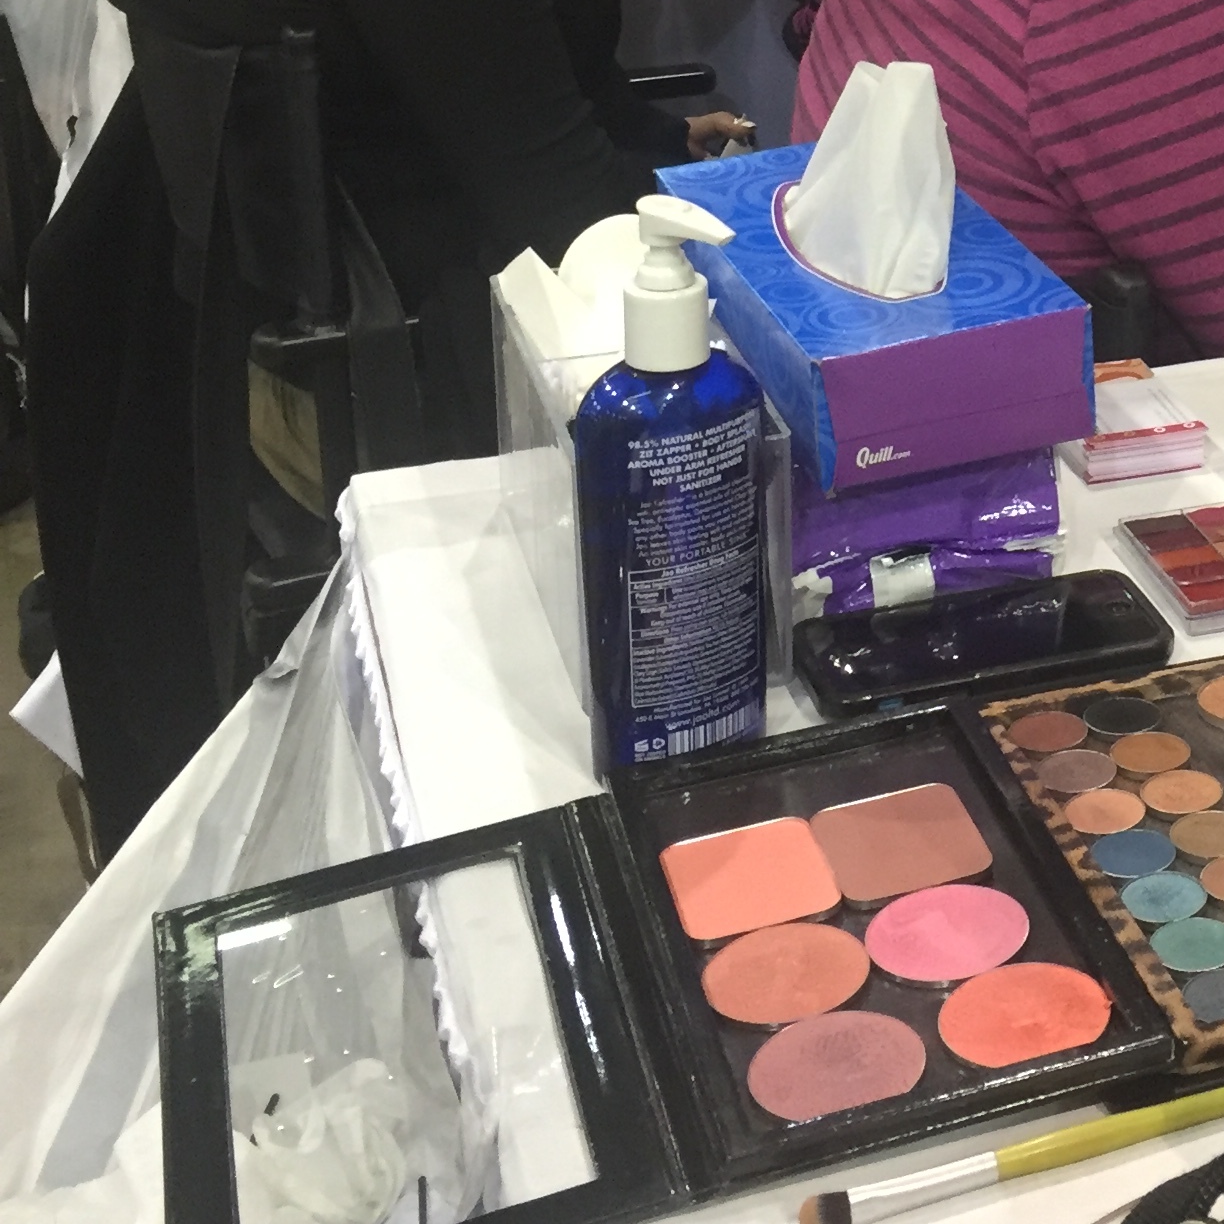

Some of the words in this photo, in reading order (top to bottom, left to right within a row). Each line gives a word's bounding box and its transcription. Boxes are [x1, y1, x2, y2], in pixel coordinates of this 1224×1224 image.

[628, 438, 659, 450] 98.5%
[661, 431, 703, 447] NATURAL
[627, 458, 665, 469] AROMA
[667, 449, 708, 464] BOOSTER
[639, 450, 654, 459] ZIT
[656, 444, 692, 457] ZAPPER
[649, 466, 682, 477] UNDER
[684, 460, 705, 472] ARM
[652, 477, 673, 487] NOT
[675, 471, 696, 483] JUST
[698, 466, 715, 478] FOR
[716, 455, 743, 473] HANDS
[679, 474, 722, 493] SANITIZER
[646, 555, 676, 567] YOUR
[679, 541, 726, 560] PORTABLE
